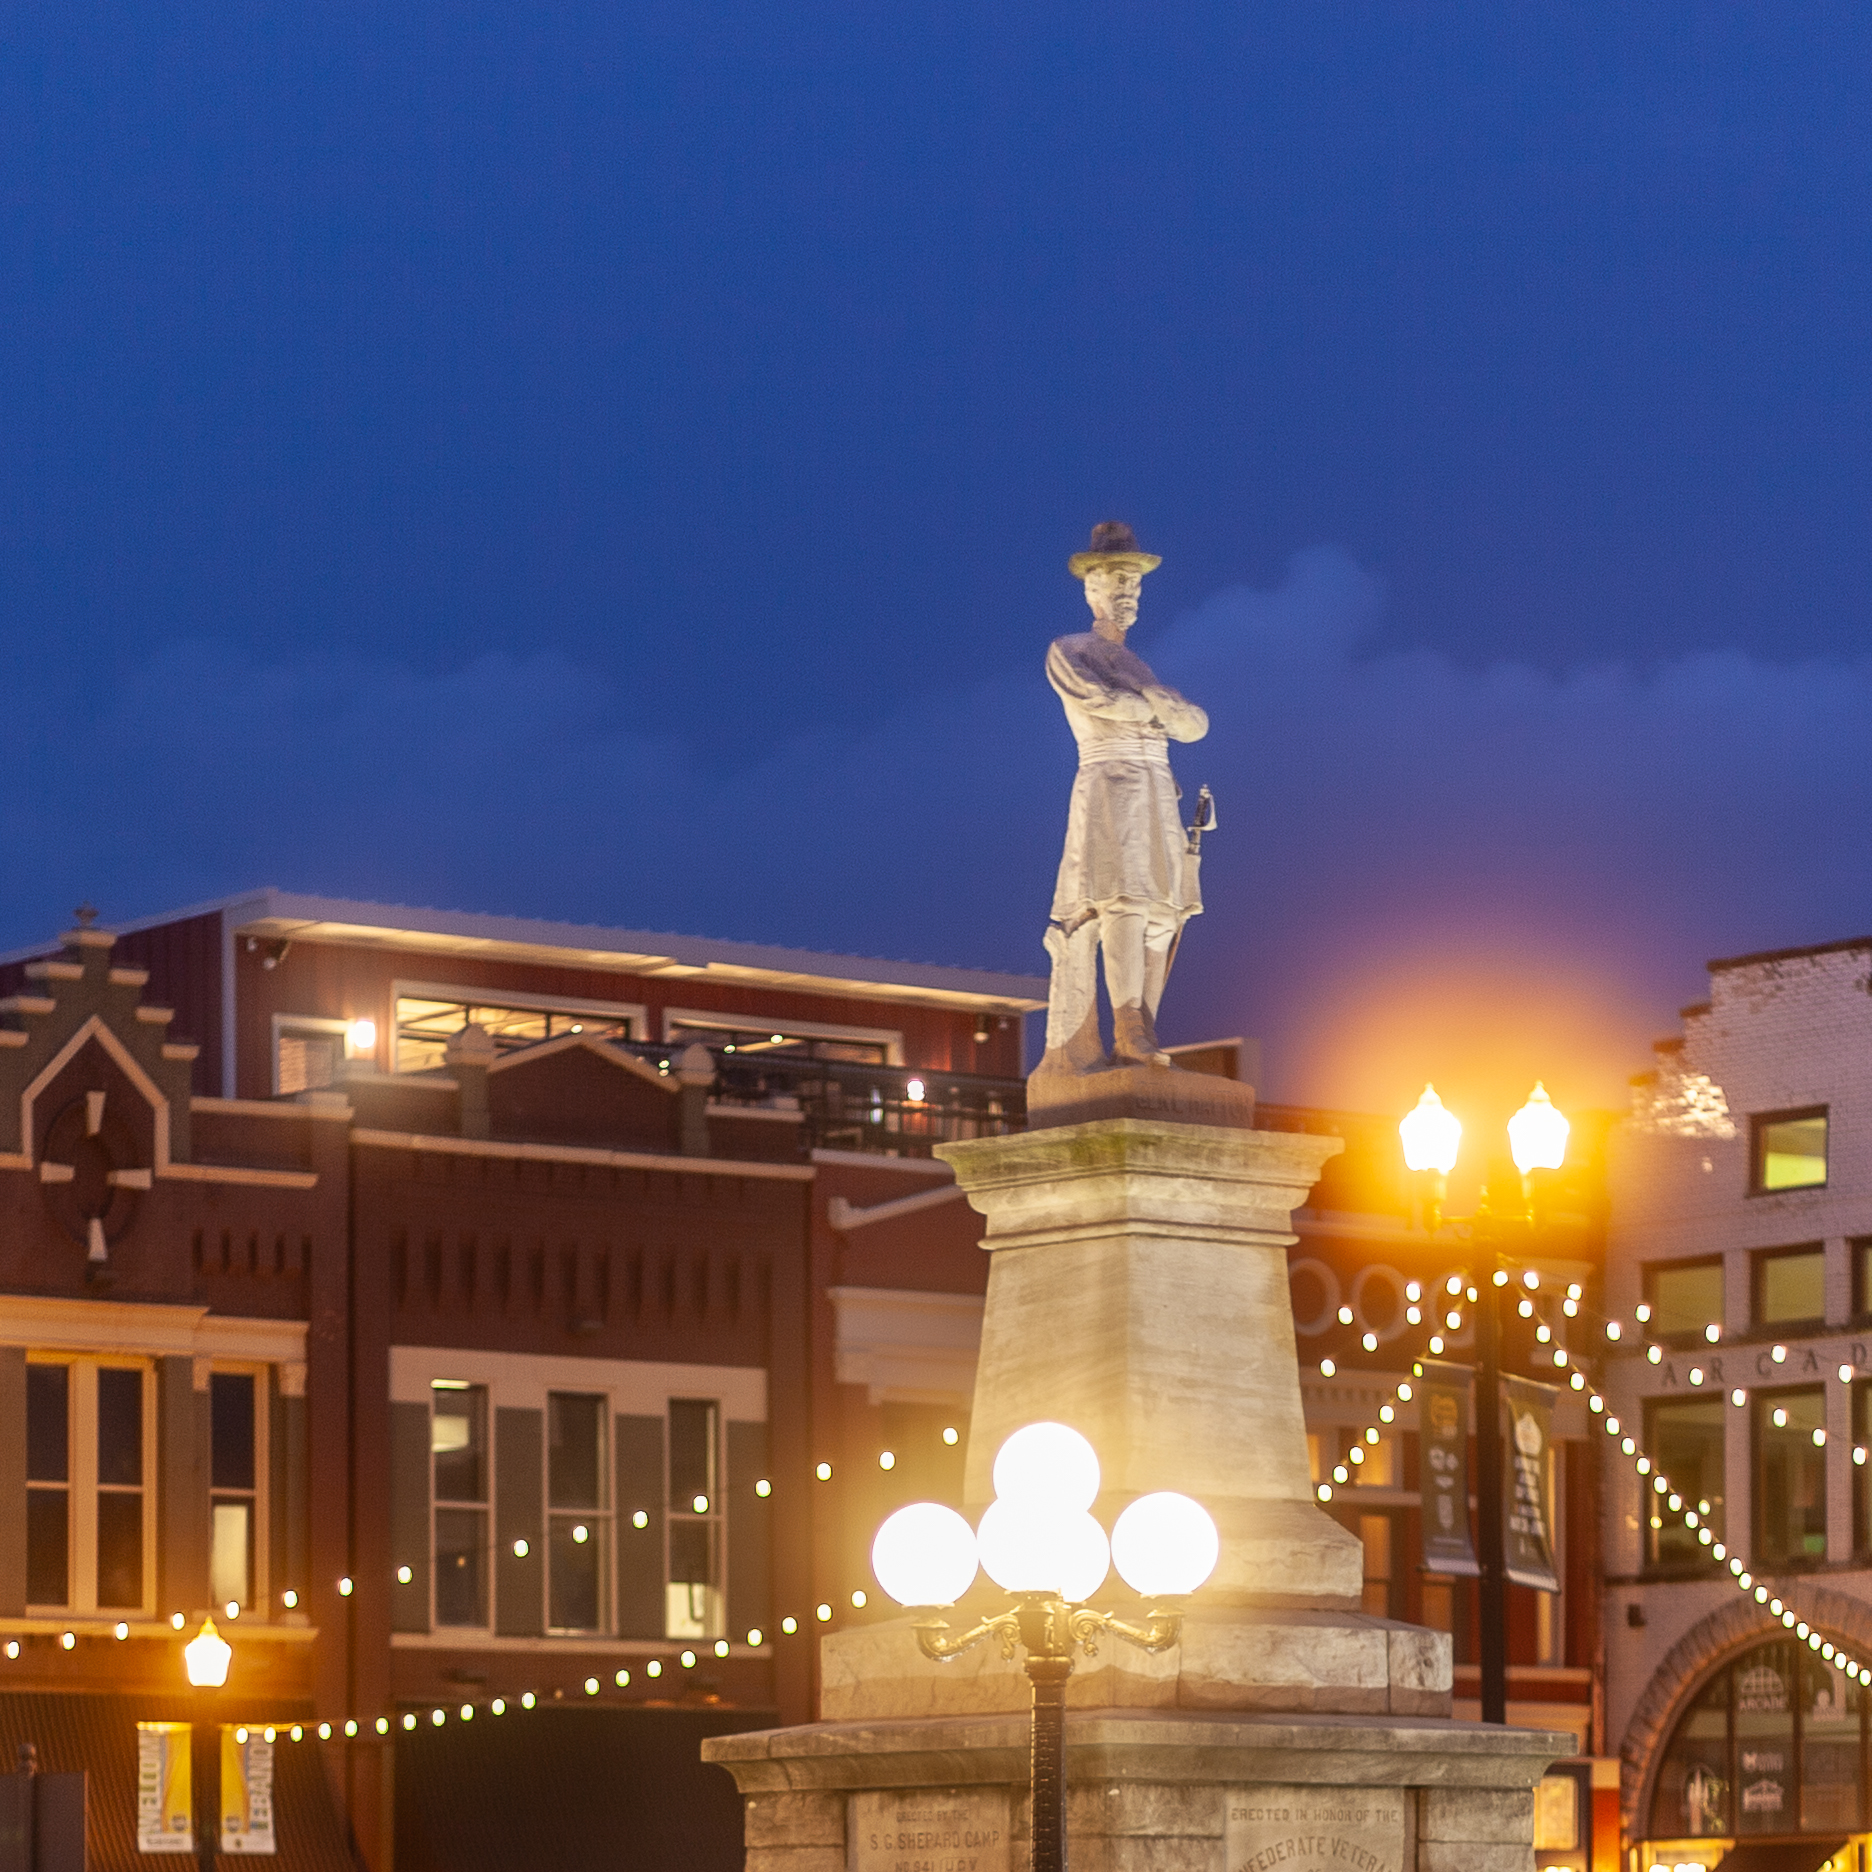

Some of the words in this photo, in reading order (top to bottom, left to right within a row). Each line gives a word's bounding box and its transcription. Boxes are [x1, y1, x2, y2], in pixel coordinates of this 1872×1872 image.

[1231, 1807, 1290, 1821] ERECTED
[1295, 1808, 1308, 1821] IN
[1314, 1808, 1352, 1822] HONOR
[1355, 1809, 1370, 1822] OF
[1376, 1809, 1398, 1823] THE
[897, 1831, 960, 1850] SHEPARD
[964, 1830, 1000, 1849] CAMP
